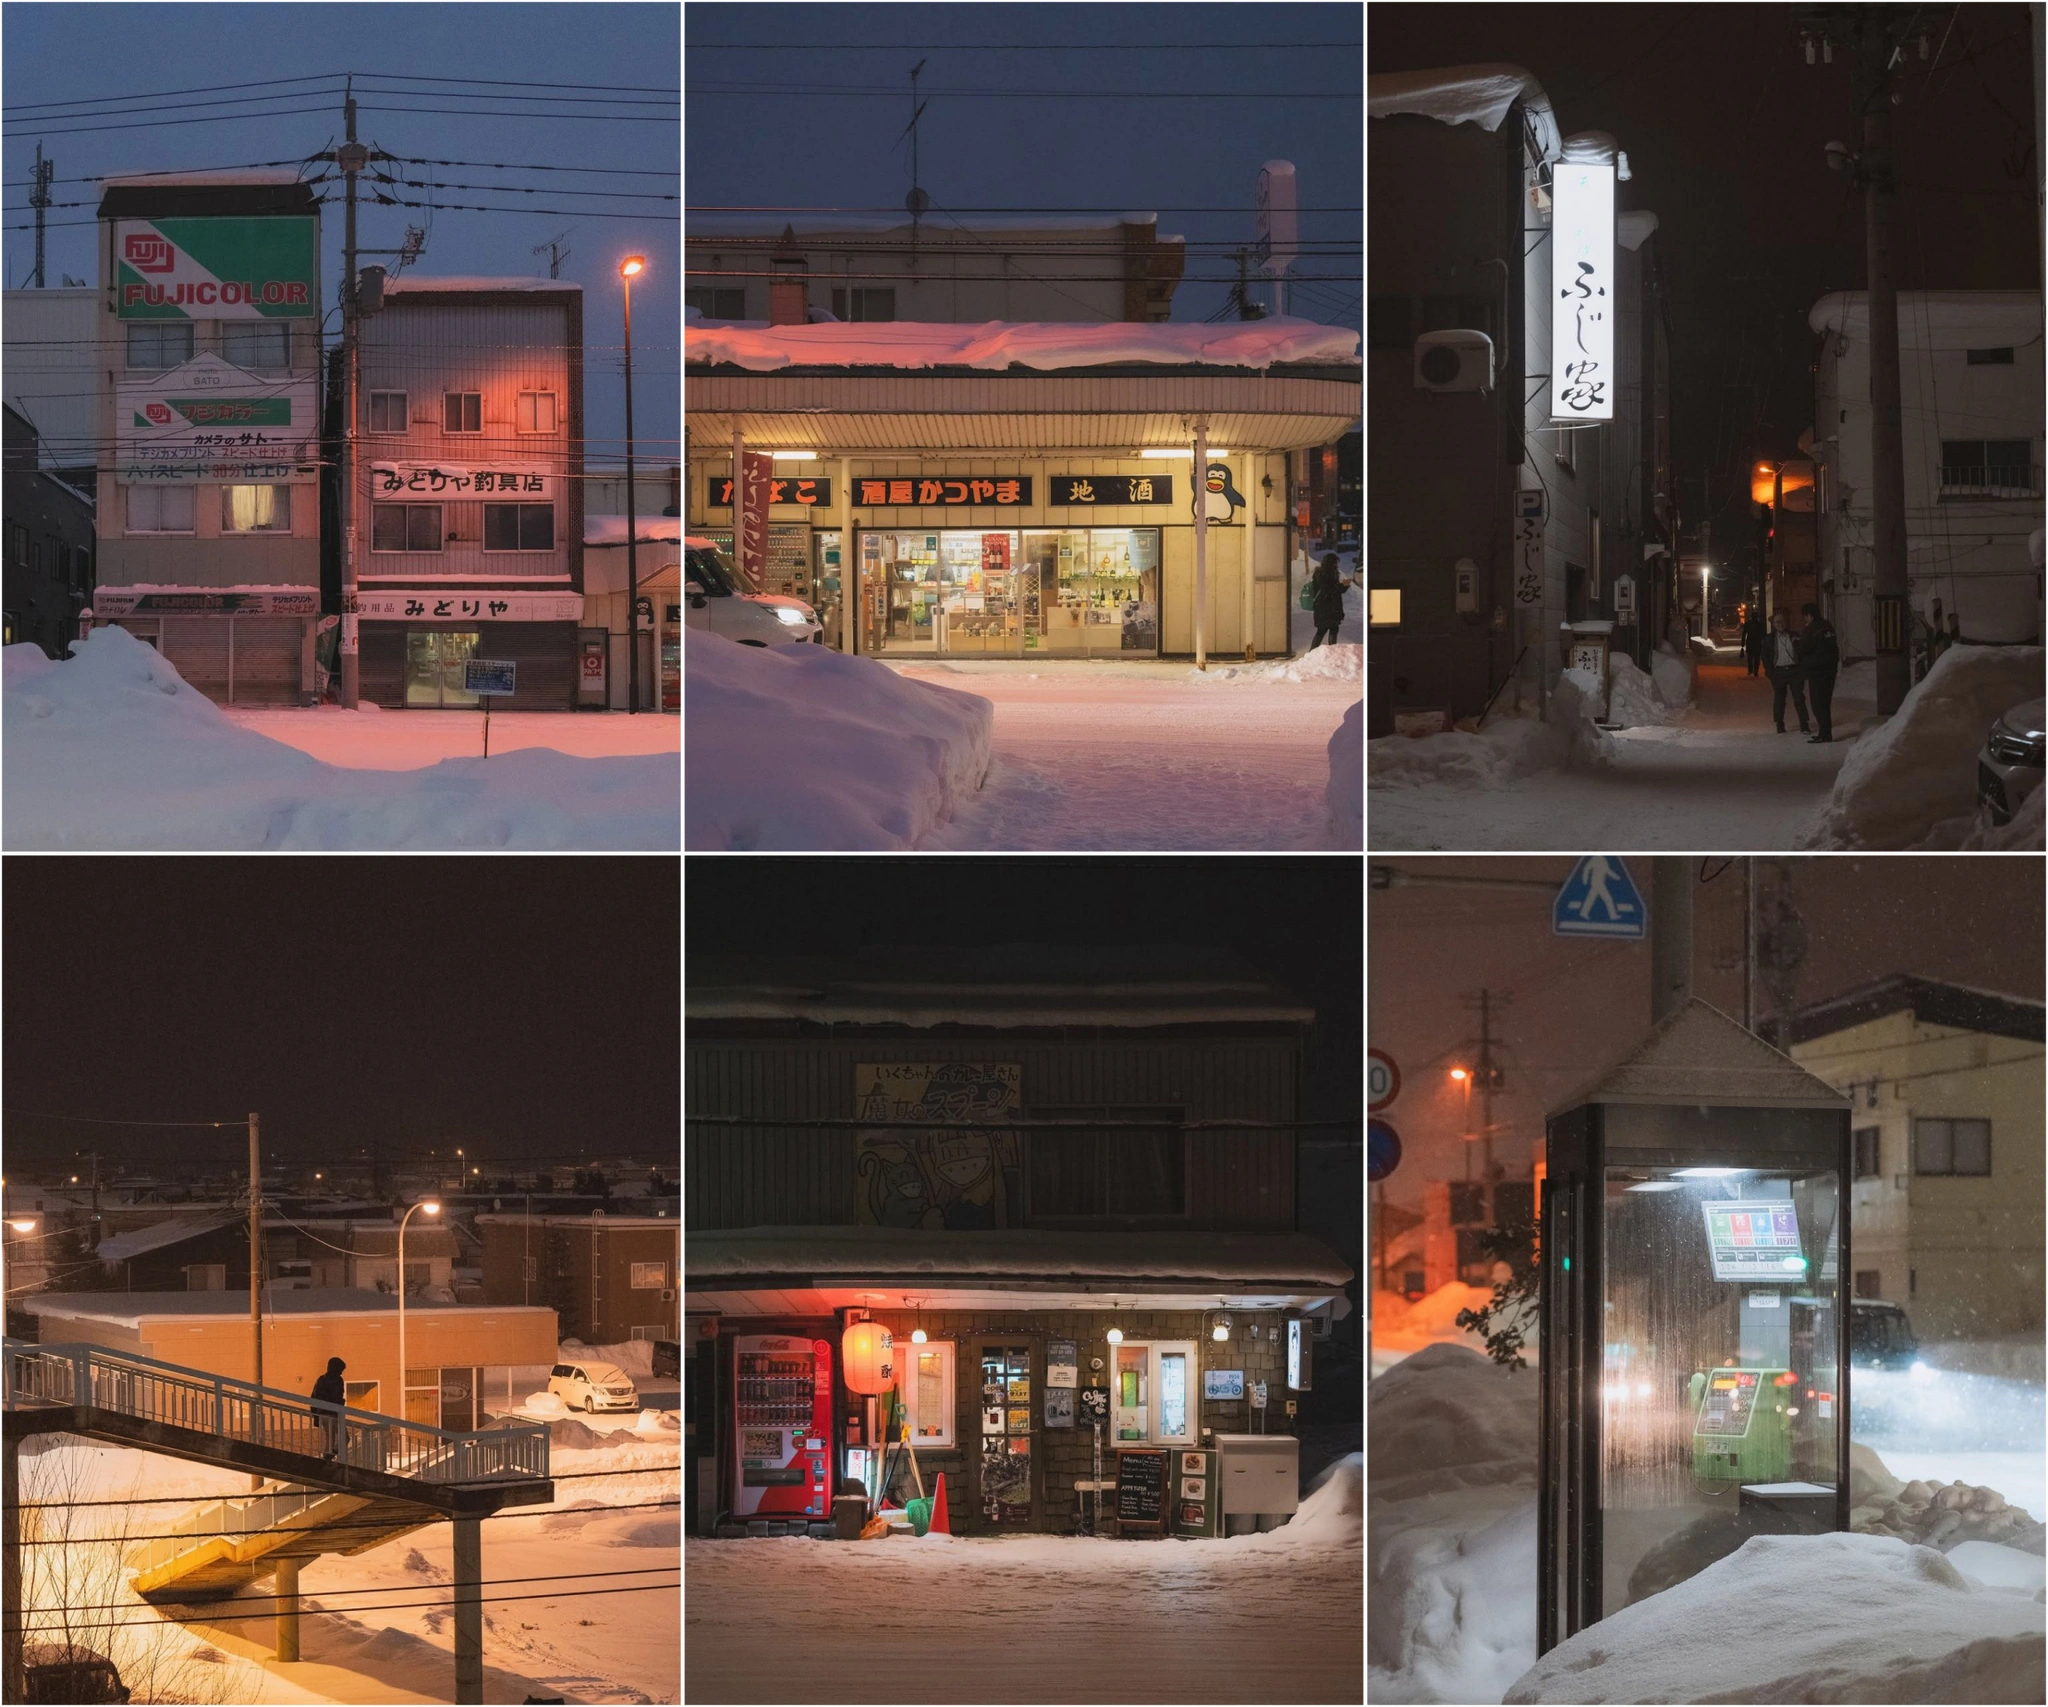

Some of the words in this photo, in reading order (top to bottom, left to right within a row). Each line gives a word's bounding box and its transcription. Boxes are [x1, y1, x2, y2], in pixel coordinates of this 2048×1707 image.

[124, 282, 308, 306] FUJICOLOR
[1561, 261, 1605, 411] ふじ家
[193, 377, 220, 385] SATO
[178, 404, 271, 421] フジカラー
[383, 471, 544, 492] みどりや釣具店
[861, 480, 1021, 505] 酒屋かつやま
[1516, 519, 1542, 603] ふじ家
[404, 600, 508, 617] みどりや
[876, 1063, 1019, 1083] いくちゃんのカレー屋さん
[858, 1083, 1017, 1120] 魔女のスプーン
[880, 1333, 894, 1379] 焼酎
[986, 1385, 1003, 1393] open
